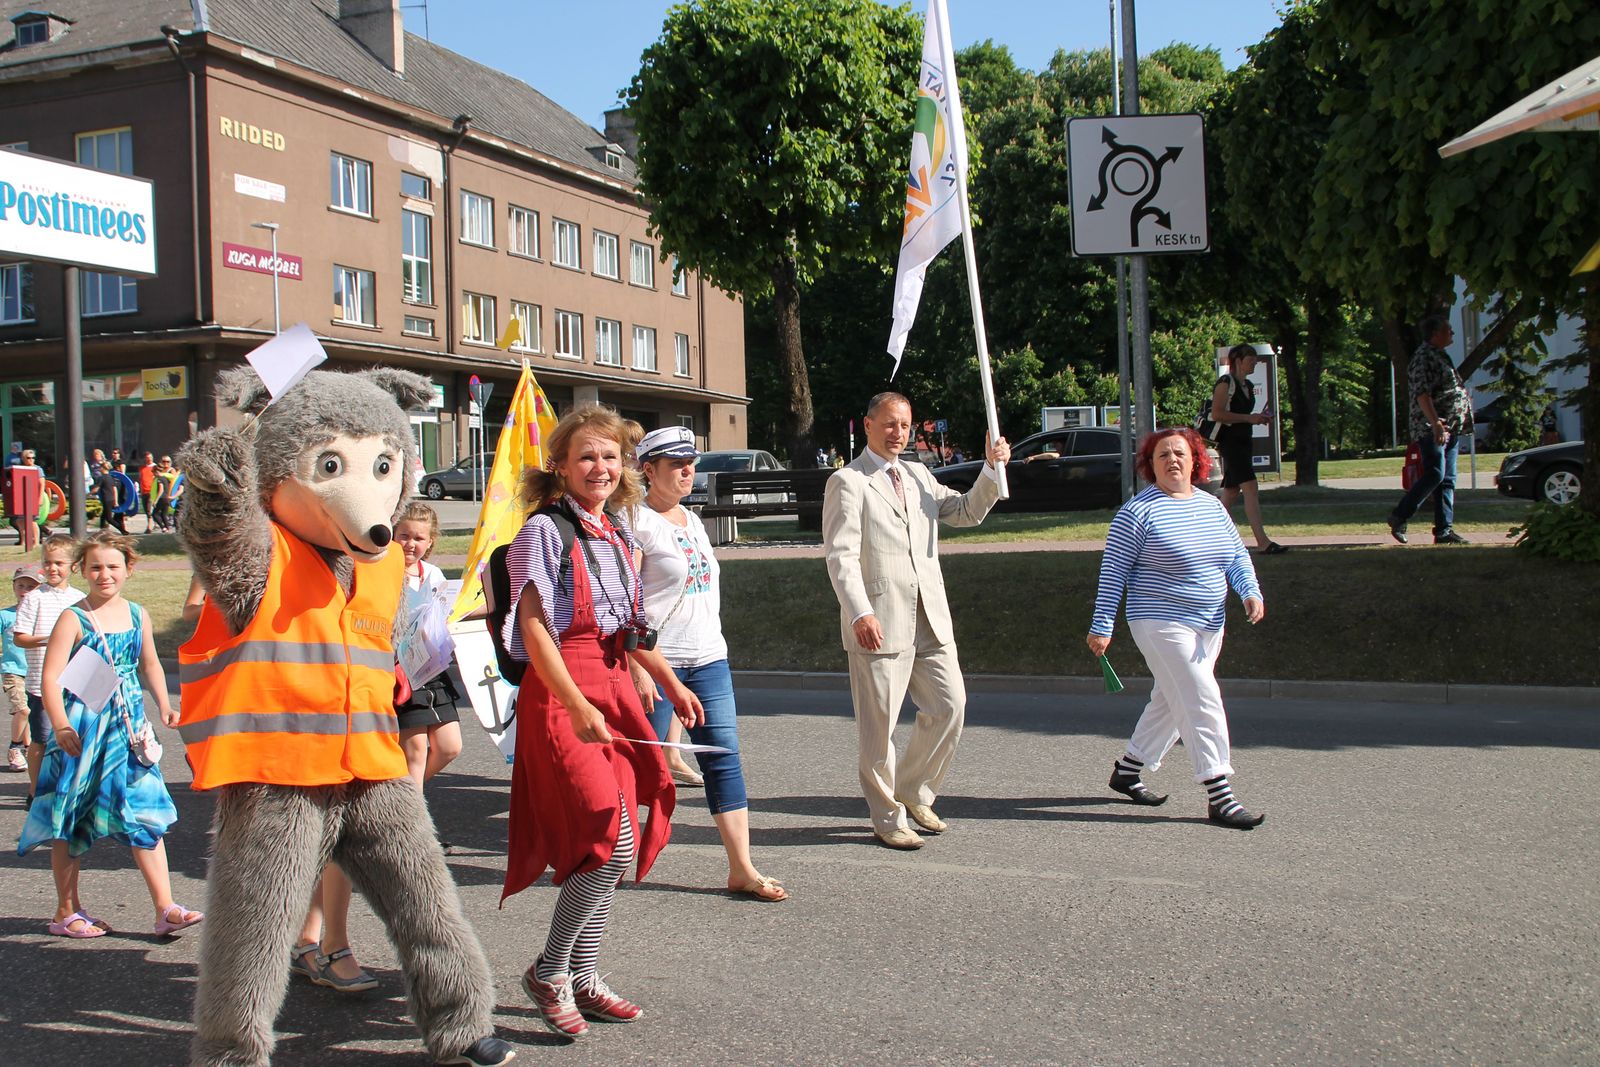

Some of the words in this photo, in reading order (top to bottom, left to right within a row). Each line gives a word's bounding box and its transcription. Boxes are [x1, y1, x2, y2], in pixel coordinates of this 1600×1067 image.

[220, 115, 286, 152] RIIDED
[0, 181, 147, 244] Postimees
[1155, 233, 1187, 246] KESK
[1189, 234, 1201, 244] tn
[228, 250, 256, 268] KUGA
